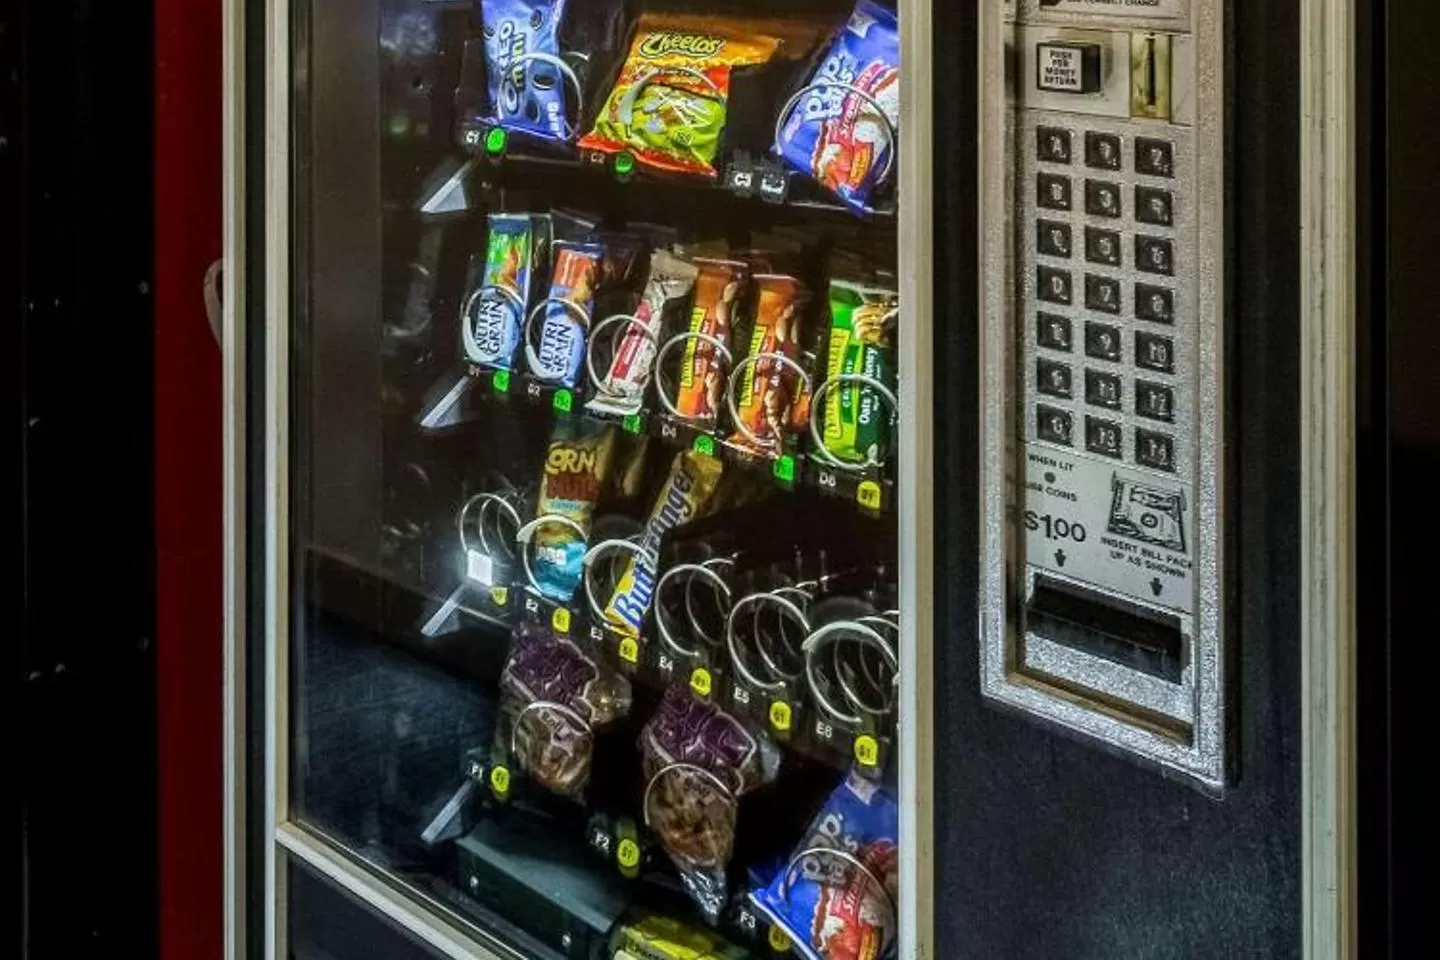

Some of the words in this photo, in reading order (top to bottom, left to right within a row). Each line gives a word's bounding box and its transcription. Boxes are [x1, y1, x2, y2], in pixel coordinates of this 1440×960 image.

[639, 32, 726, 58] Cheetos
[476, 297, 492, 351] NUTRI
[487, 300, 504, 355] GRAIN
[859, 397, 872, 424] Oats
[545, 443, 595, 473] CORN
[1028, 453, 1057, 467] WHEN
[1059, 460, 1075, 472] LIT
[1045, 487, 1077, 502] COINS
[1024, 510, 1086, 542] $1.00
[1101, 537, 1138, 554] INSERT
[1141, 547, 1163, 561] BILL
[1110, 550, 1125, 560] UP
[1128, 556, 1142, 567] AS
[1145, 560, 1186, 578] SHOWN
[660, 657, 673, 671] E4
[735, 687, 750, 703] E5
[816, 722, 832, 738] E6
[740, 911, 756, 928] F3
